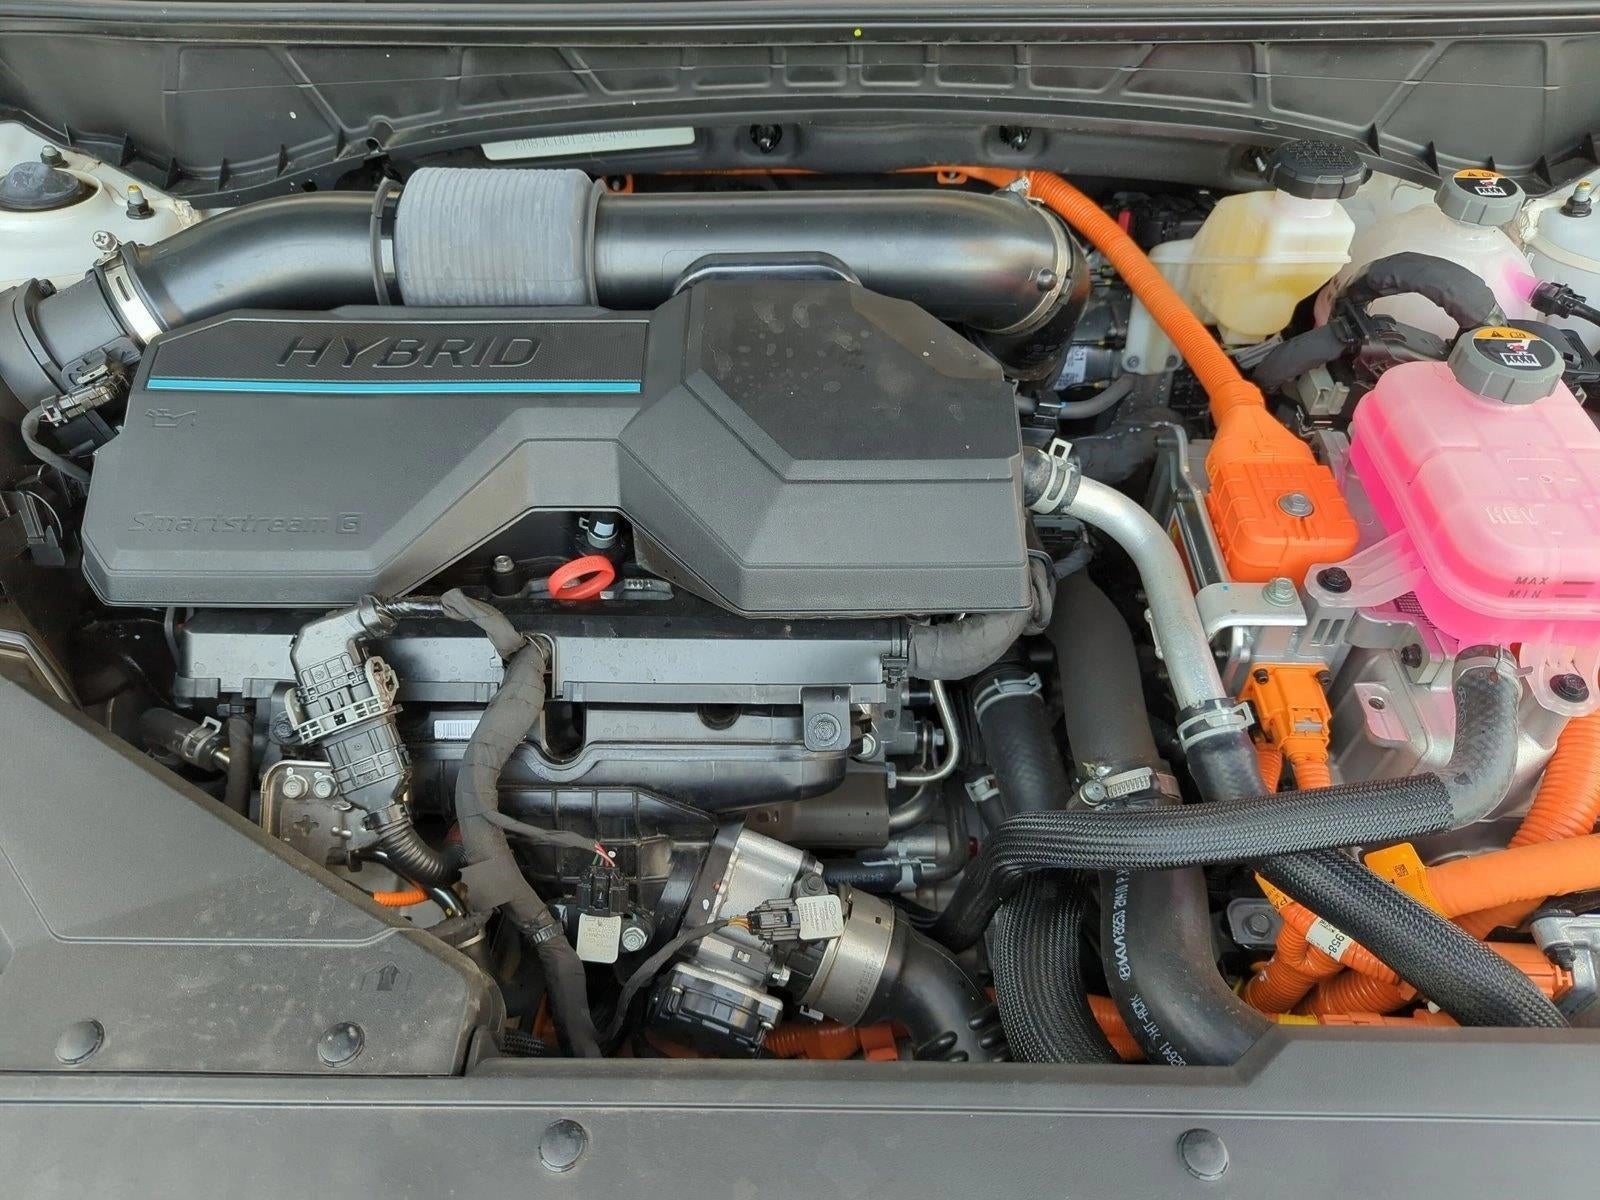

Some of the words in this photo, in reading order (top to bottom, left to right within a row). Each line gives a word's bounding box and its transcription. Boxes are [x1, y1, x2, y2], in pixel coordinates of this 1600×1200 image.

[275, 335, 543, 369] HYBRID
[127, 512, 330, 534] Smartstream
[1514, 576, 1549, 586] MAX
[1507, 589, 1542, 599] MIN
